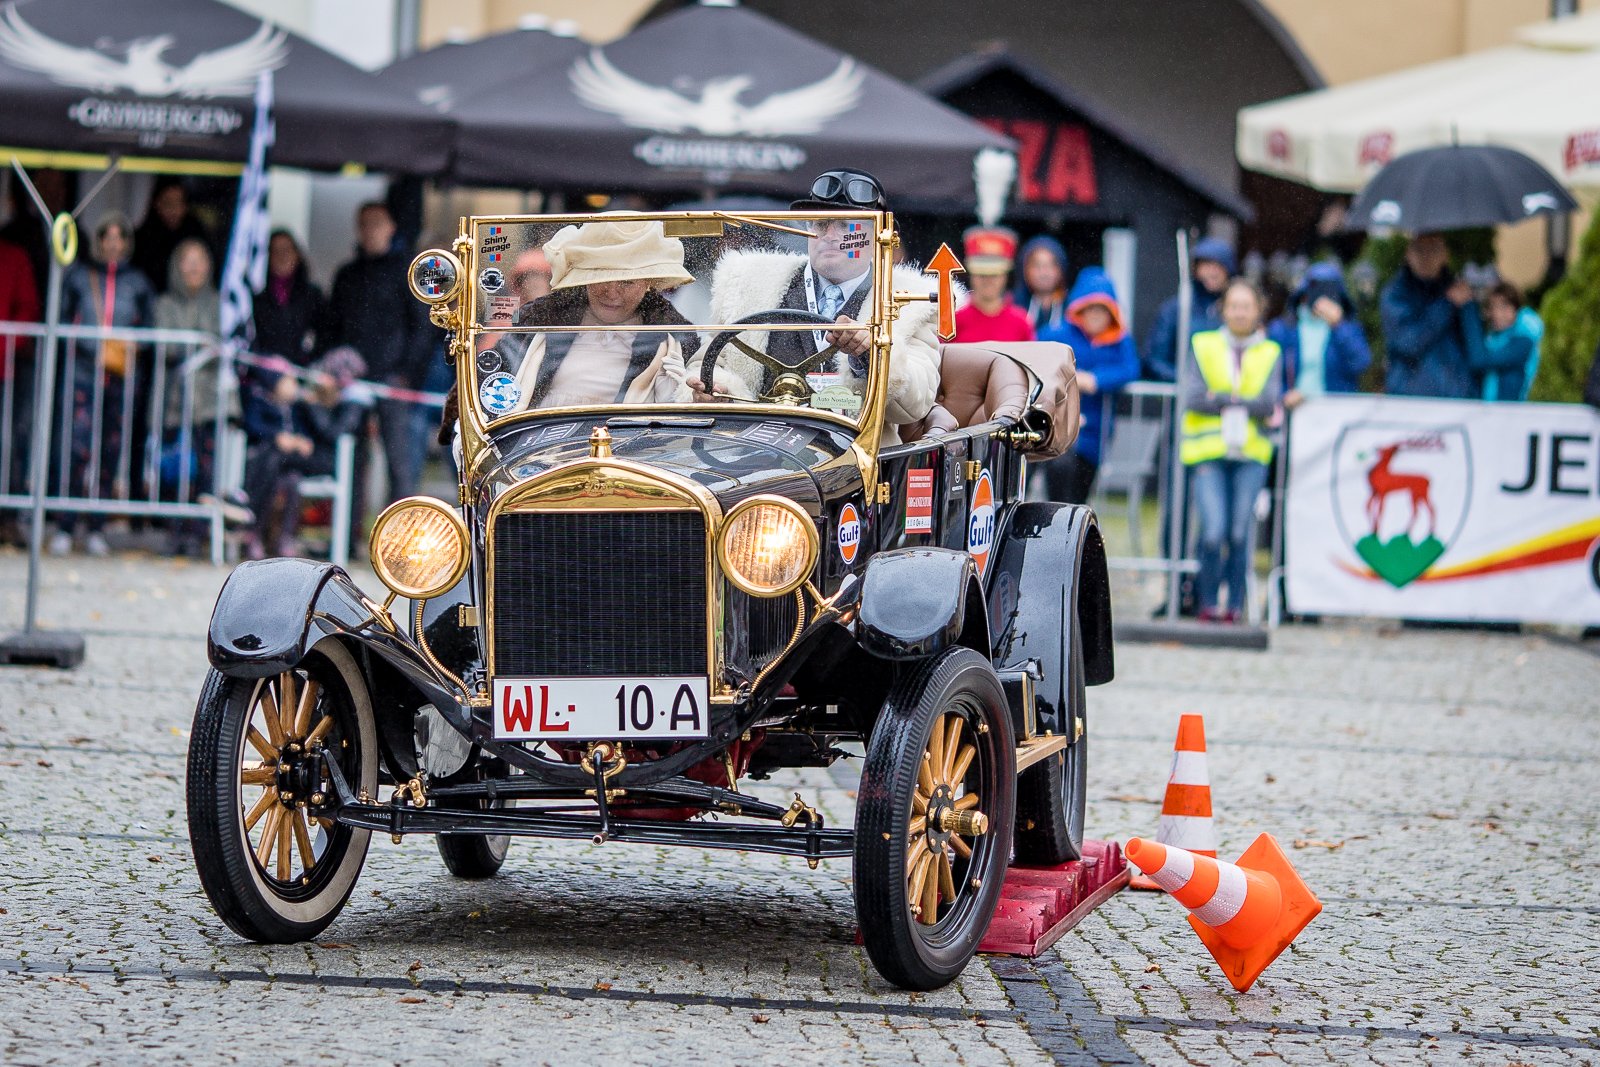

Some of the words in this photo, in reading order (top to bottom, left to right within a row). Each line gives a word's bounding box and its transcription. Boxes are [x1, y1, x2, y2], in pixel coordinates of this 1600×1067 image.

[484, 235, 508, 246] Shiny
[843, 232, 867, 242] Shiny
[480, 242, 511, 254] Garage
[839, 239, 870, 250] Garage
[423, 268, 446, 278] Shiny
[419, 276, 449, 287] Garage
[1501, 432, 1600, 496] JE
[839, 524, 859, 543] Gulf
[968, 514, 993, 547] Gulf
